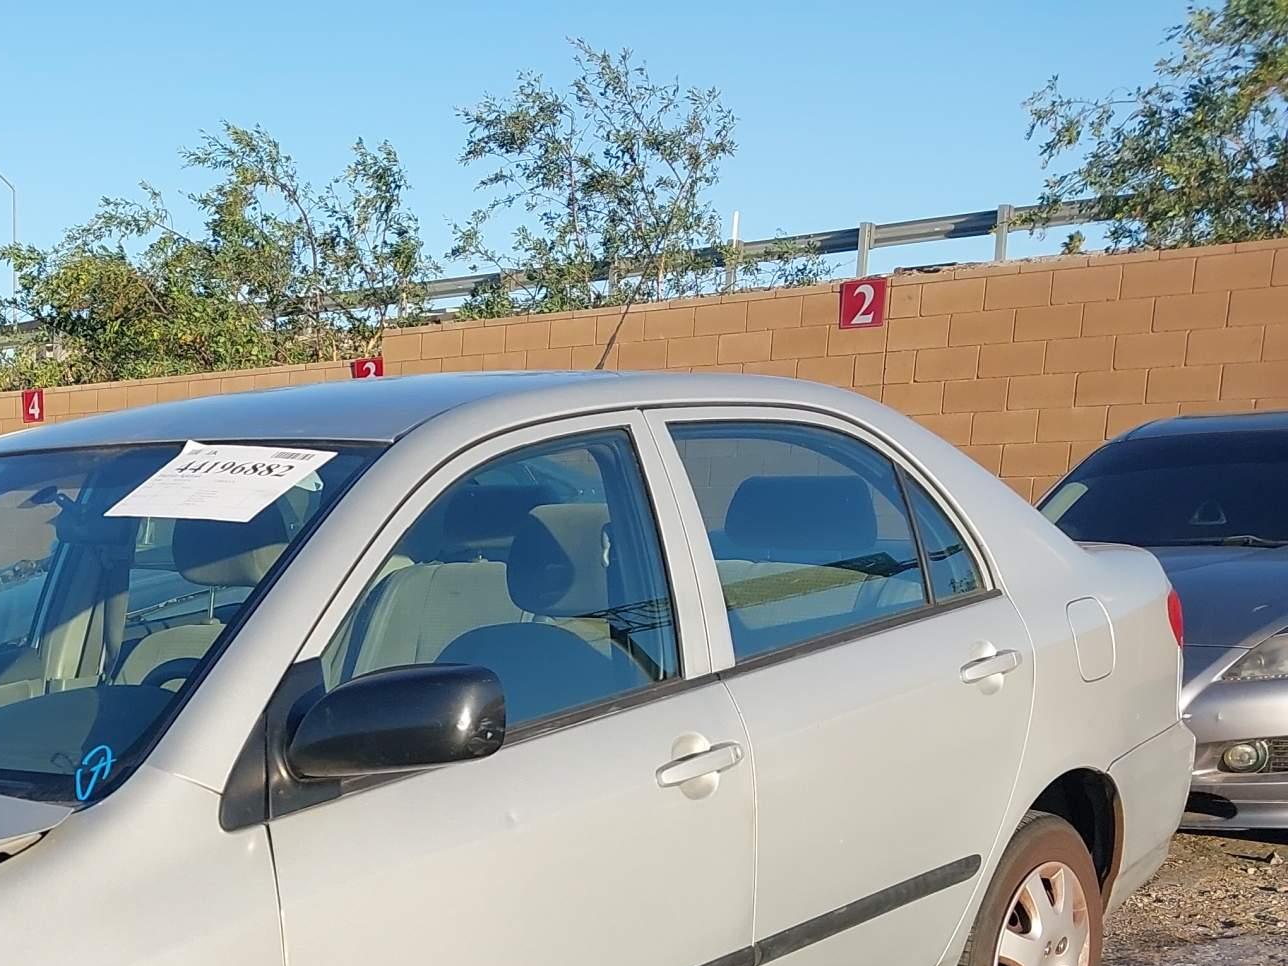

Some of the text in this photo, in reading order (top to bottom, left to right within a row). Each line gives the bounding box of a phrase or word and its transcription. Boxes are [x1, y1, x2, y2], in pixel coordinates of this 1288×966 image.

[851, 284, 874, 324] 2
[28, 391, 40, 420] 4
[176, 460, 294, 478] 44196882
